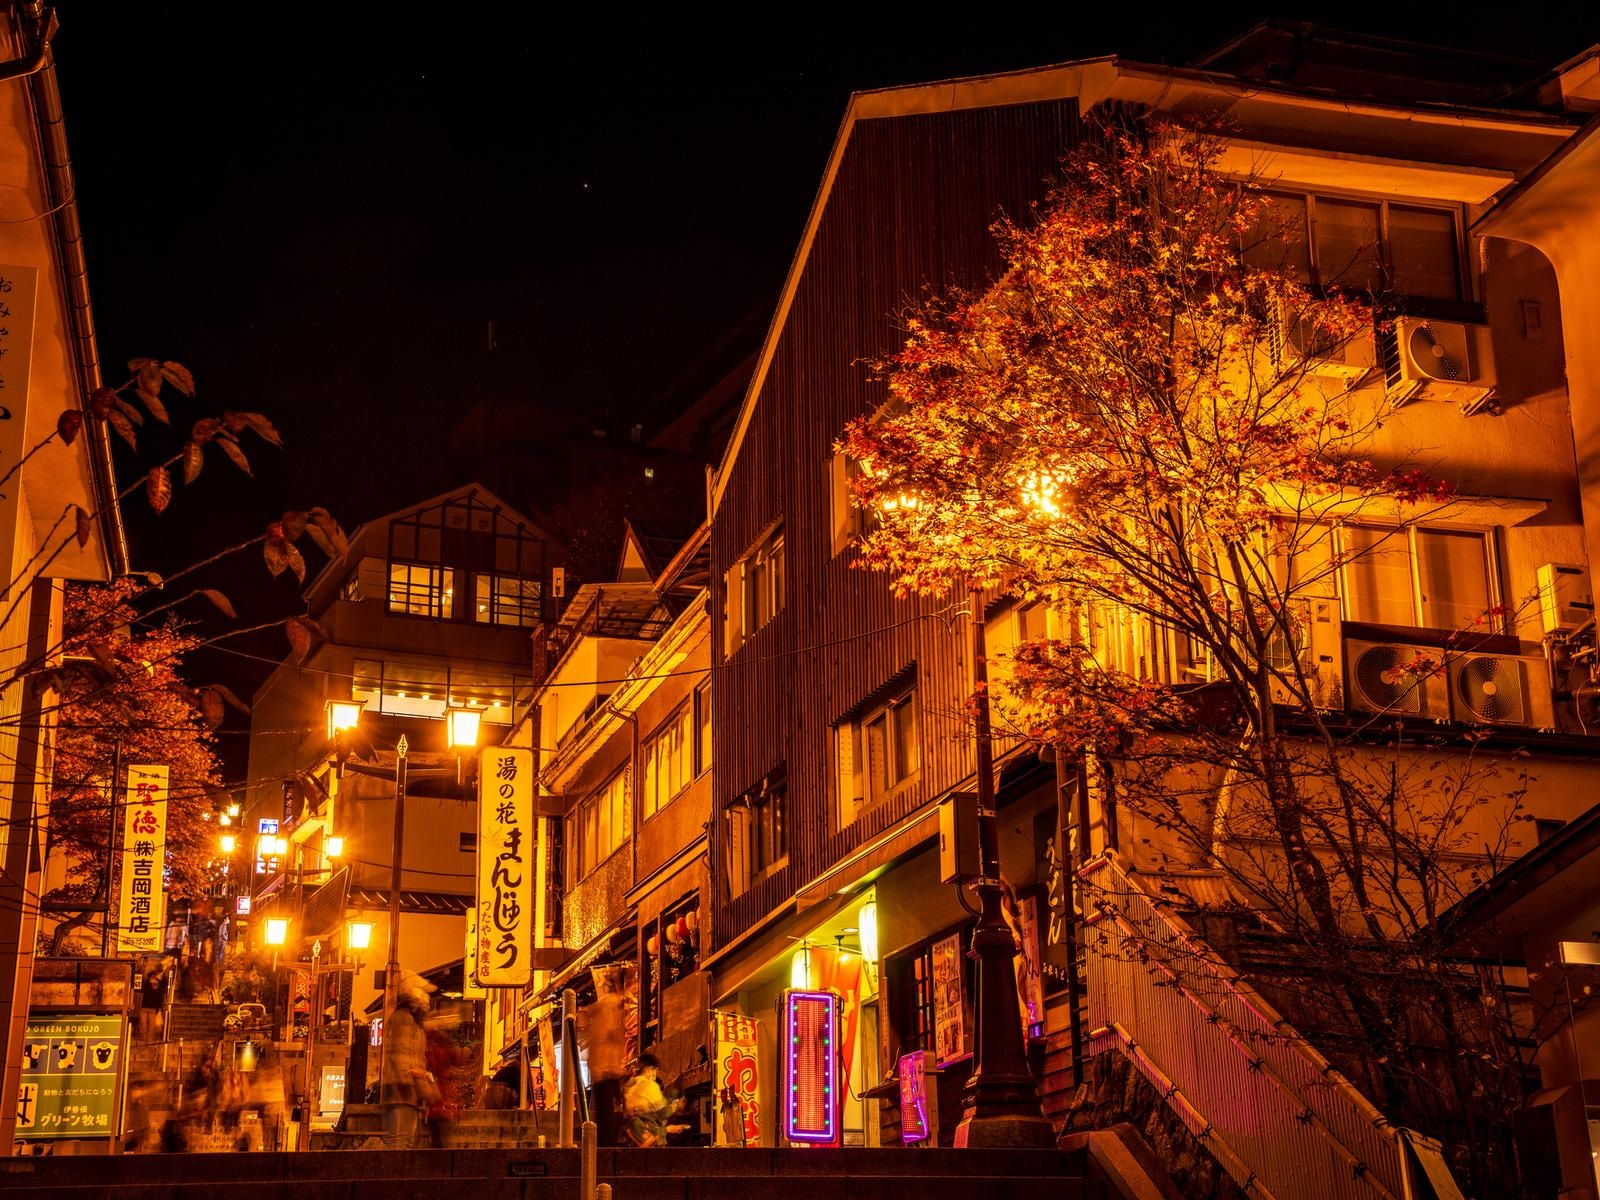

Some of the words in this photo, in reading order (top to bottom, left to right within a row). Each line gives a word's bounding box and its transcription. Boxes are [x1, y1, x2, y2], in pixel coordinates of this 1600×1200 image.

[33, 1025, 62, 1033] GREEN
[65, 1025, 100, 1033] BOKUJO
[41, 1113, 108, 1127] グリーン牧場
